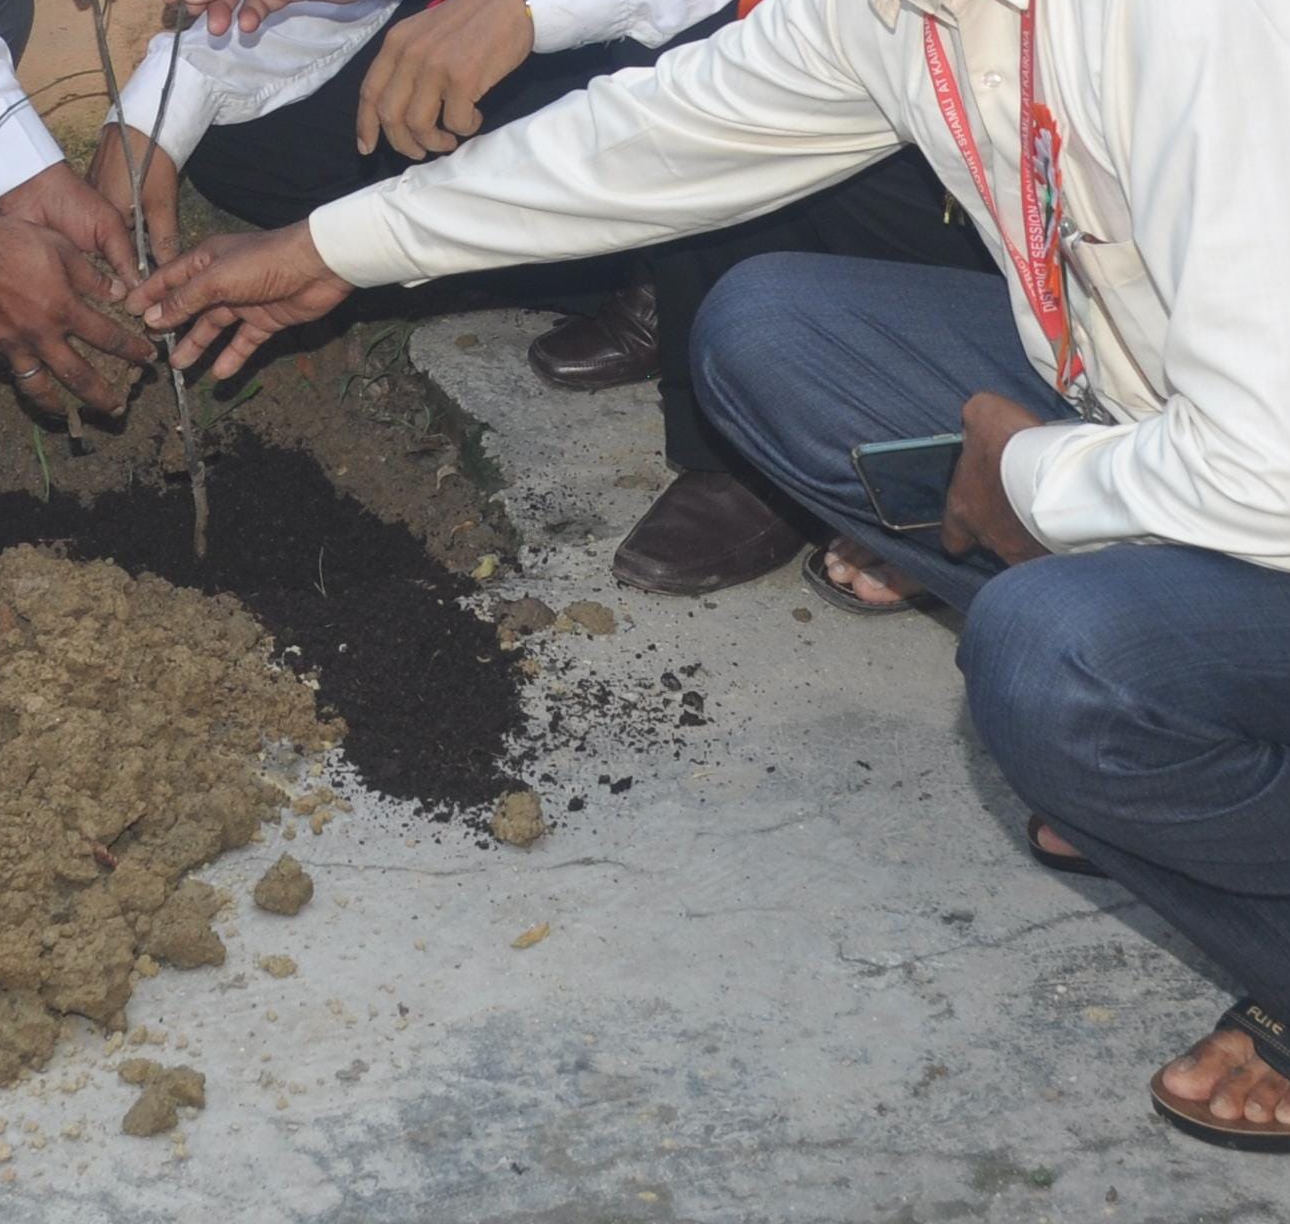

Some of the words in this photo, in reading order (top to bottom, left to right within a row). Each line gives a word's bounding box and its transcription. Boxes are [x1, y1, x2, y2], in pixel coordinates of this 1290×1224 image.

[935, 78, 950, 94] AT
[942, 100, 968, 147] SHAMLI
[1026, 203, 1046, 258] SESSION
